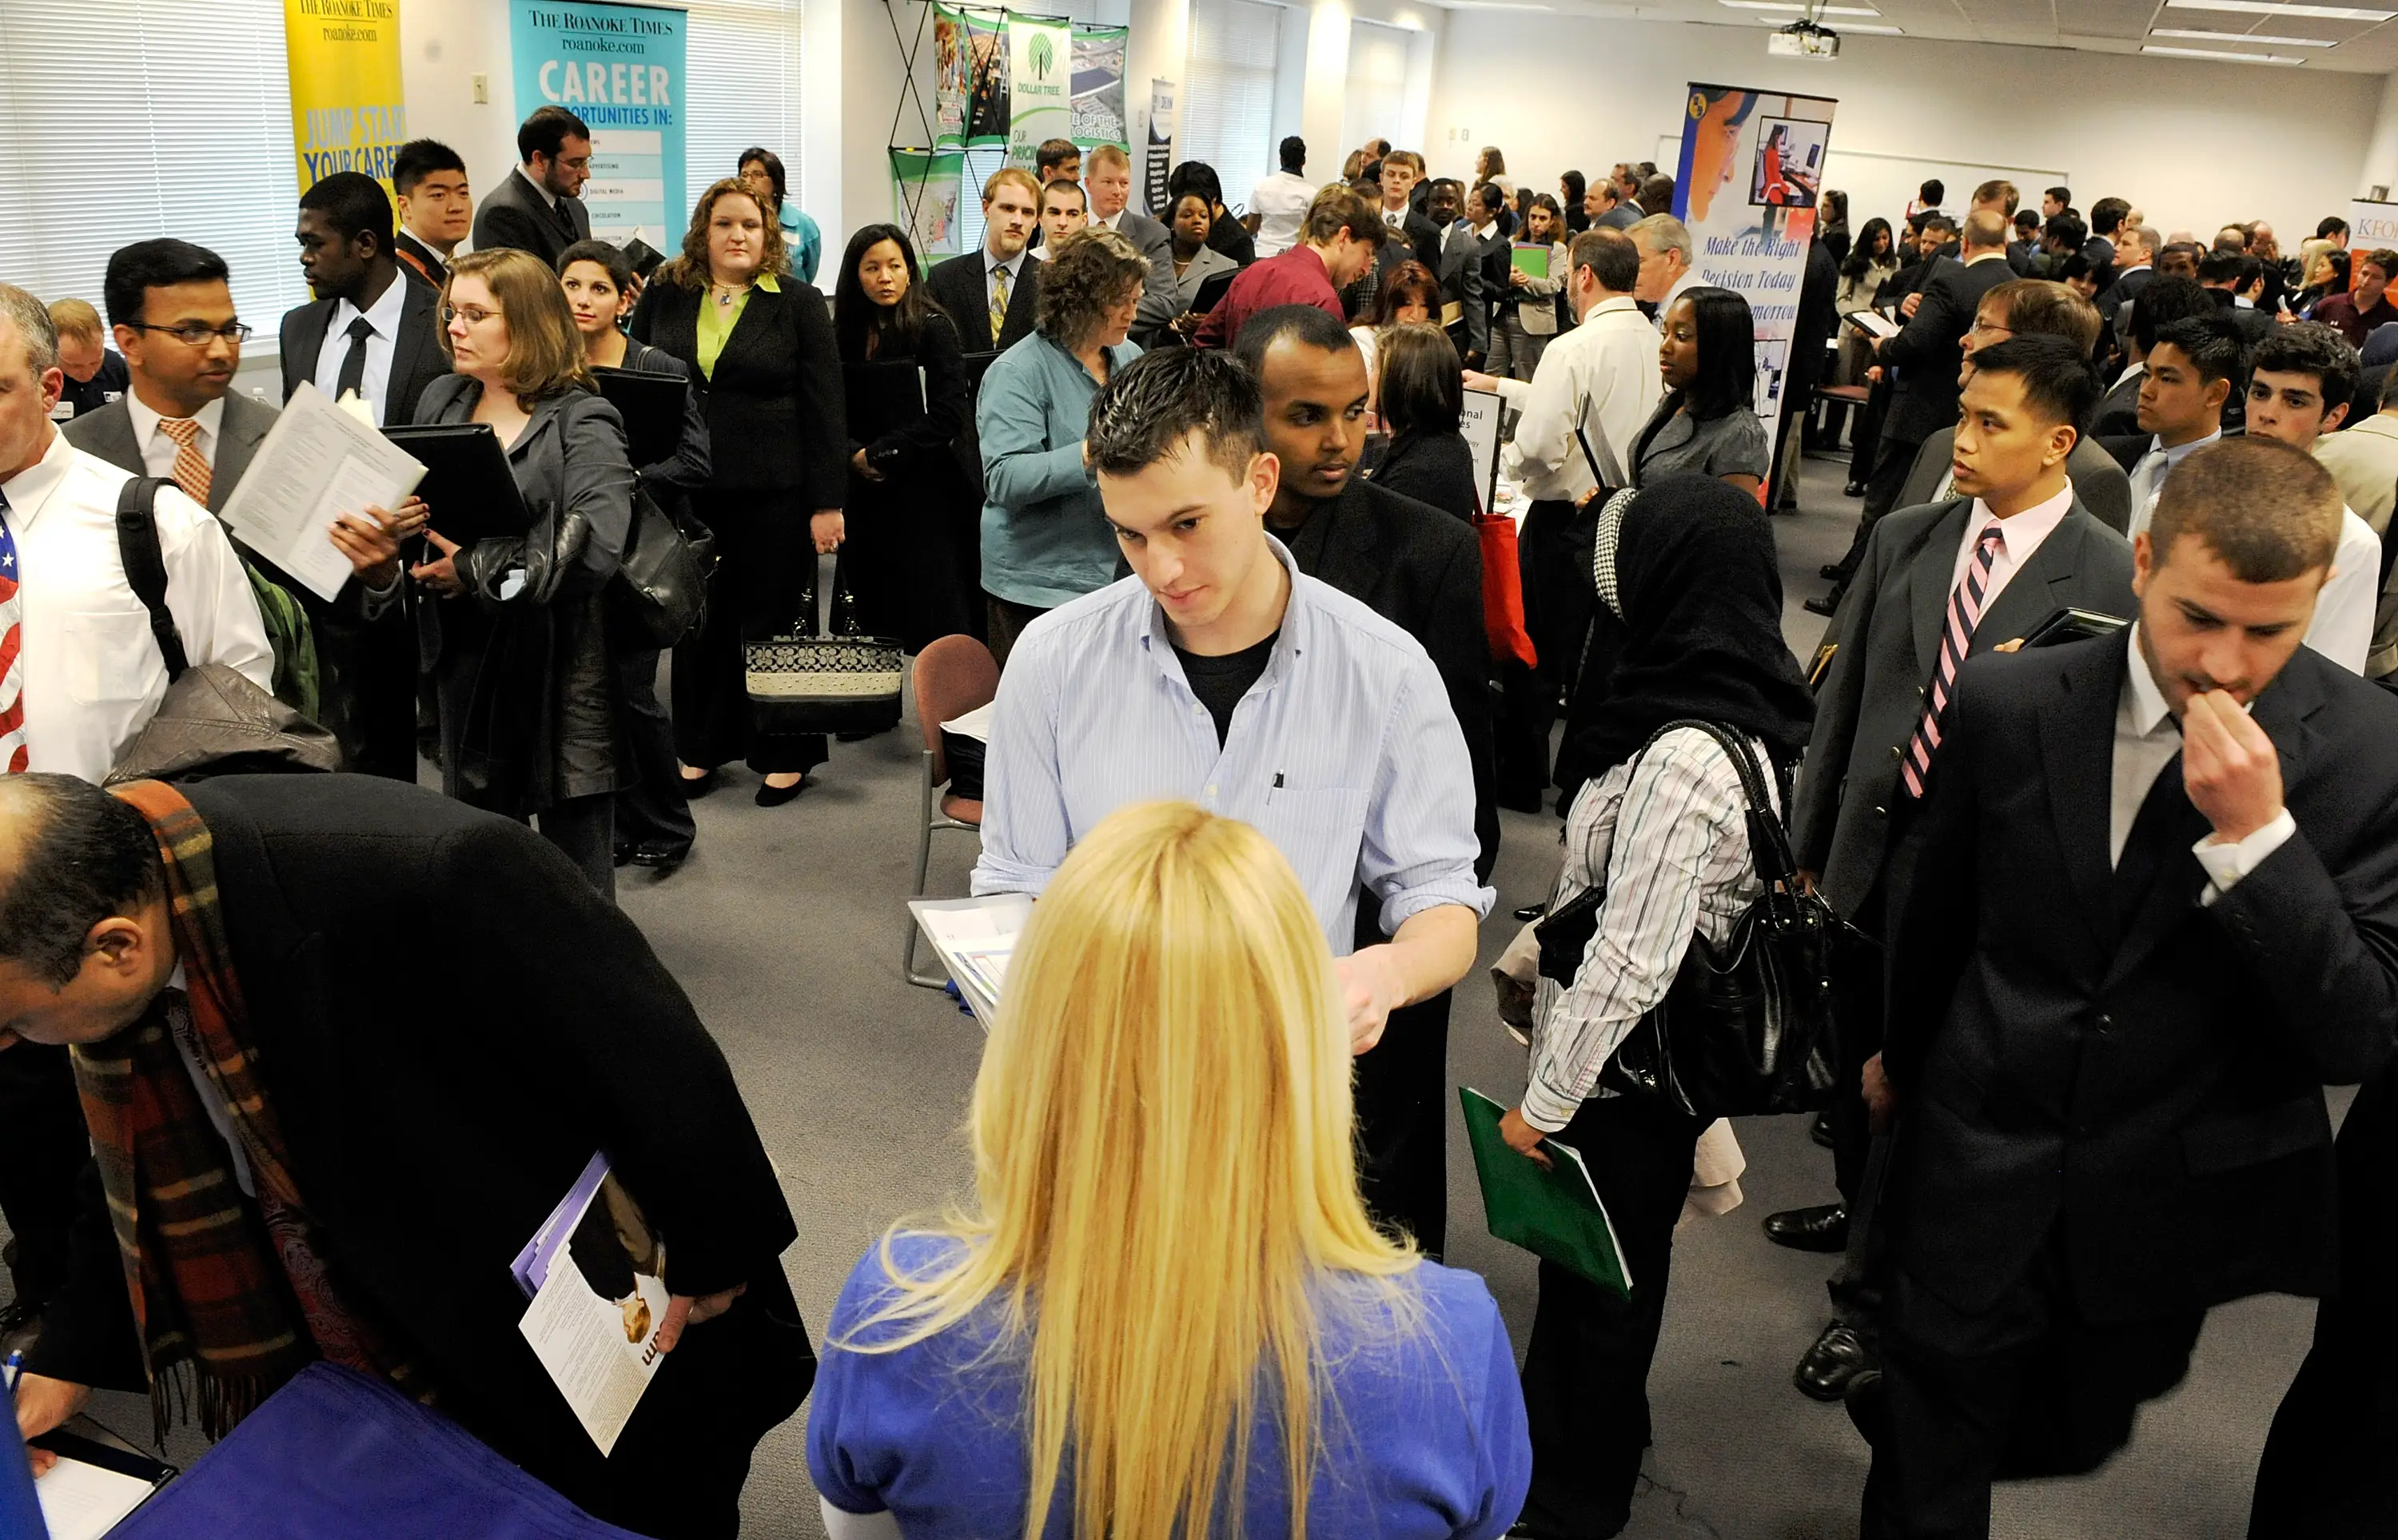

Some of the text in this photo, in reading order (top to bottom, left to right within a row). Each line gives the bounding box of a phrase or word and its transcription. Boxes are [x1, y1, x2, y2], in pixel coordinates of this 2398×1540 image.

[301, 0, 393, 18] THE ROANOKE TIMES
[323, 23, 377, 42] roanoke.com
[528, 10, 673, 35] THE ROANOKE TIMES
[562, 38, 644, 54] roanoke.com
[539, 59, 671, 106] CAREER
[1018, 82, 1061, 96] DOLLAR TREE
[563, 105, 672, 125] ORTUNITIES IN:
[1082, 113, 1096, 125] OF
[1098, 115, 1117, 128] THE
[303, 105, 408, 150] JUMP STAR
[1703, 237, 1801, 261] Make the Right
[1758, 270, 1797, 292] Today
